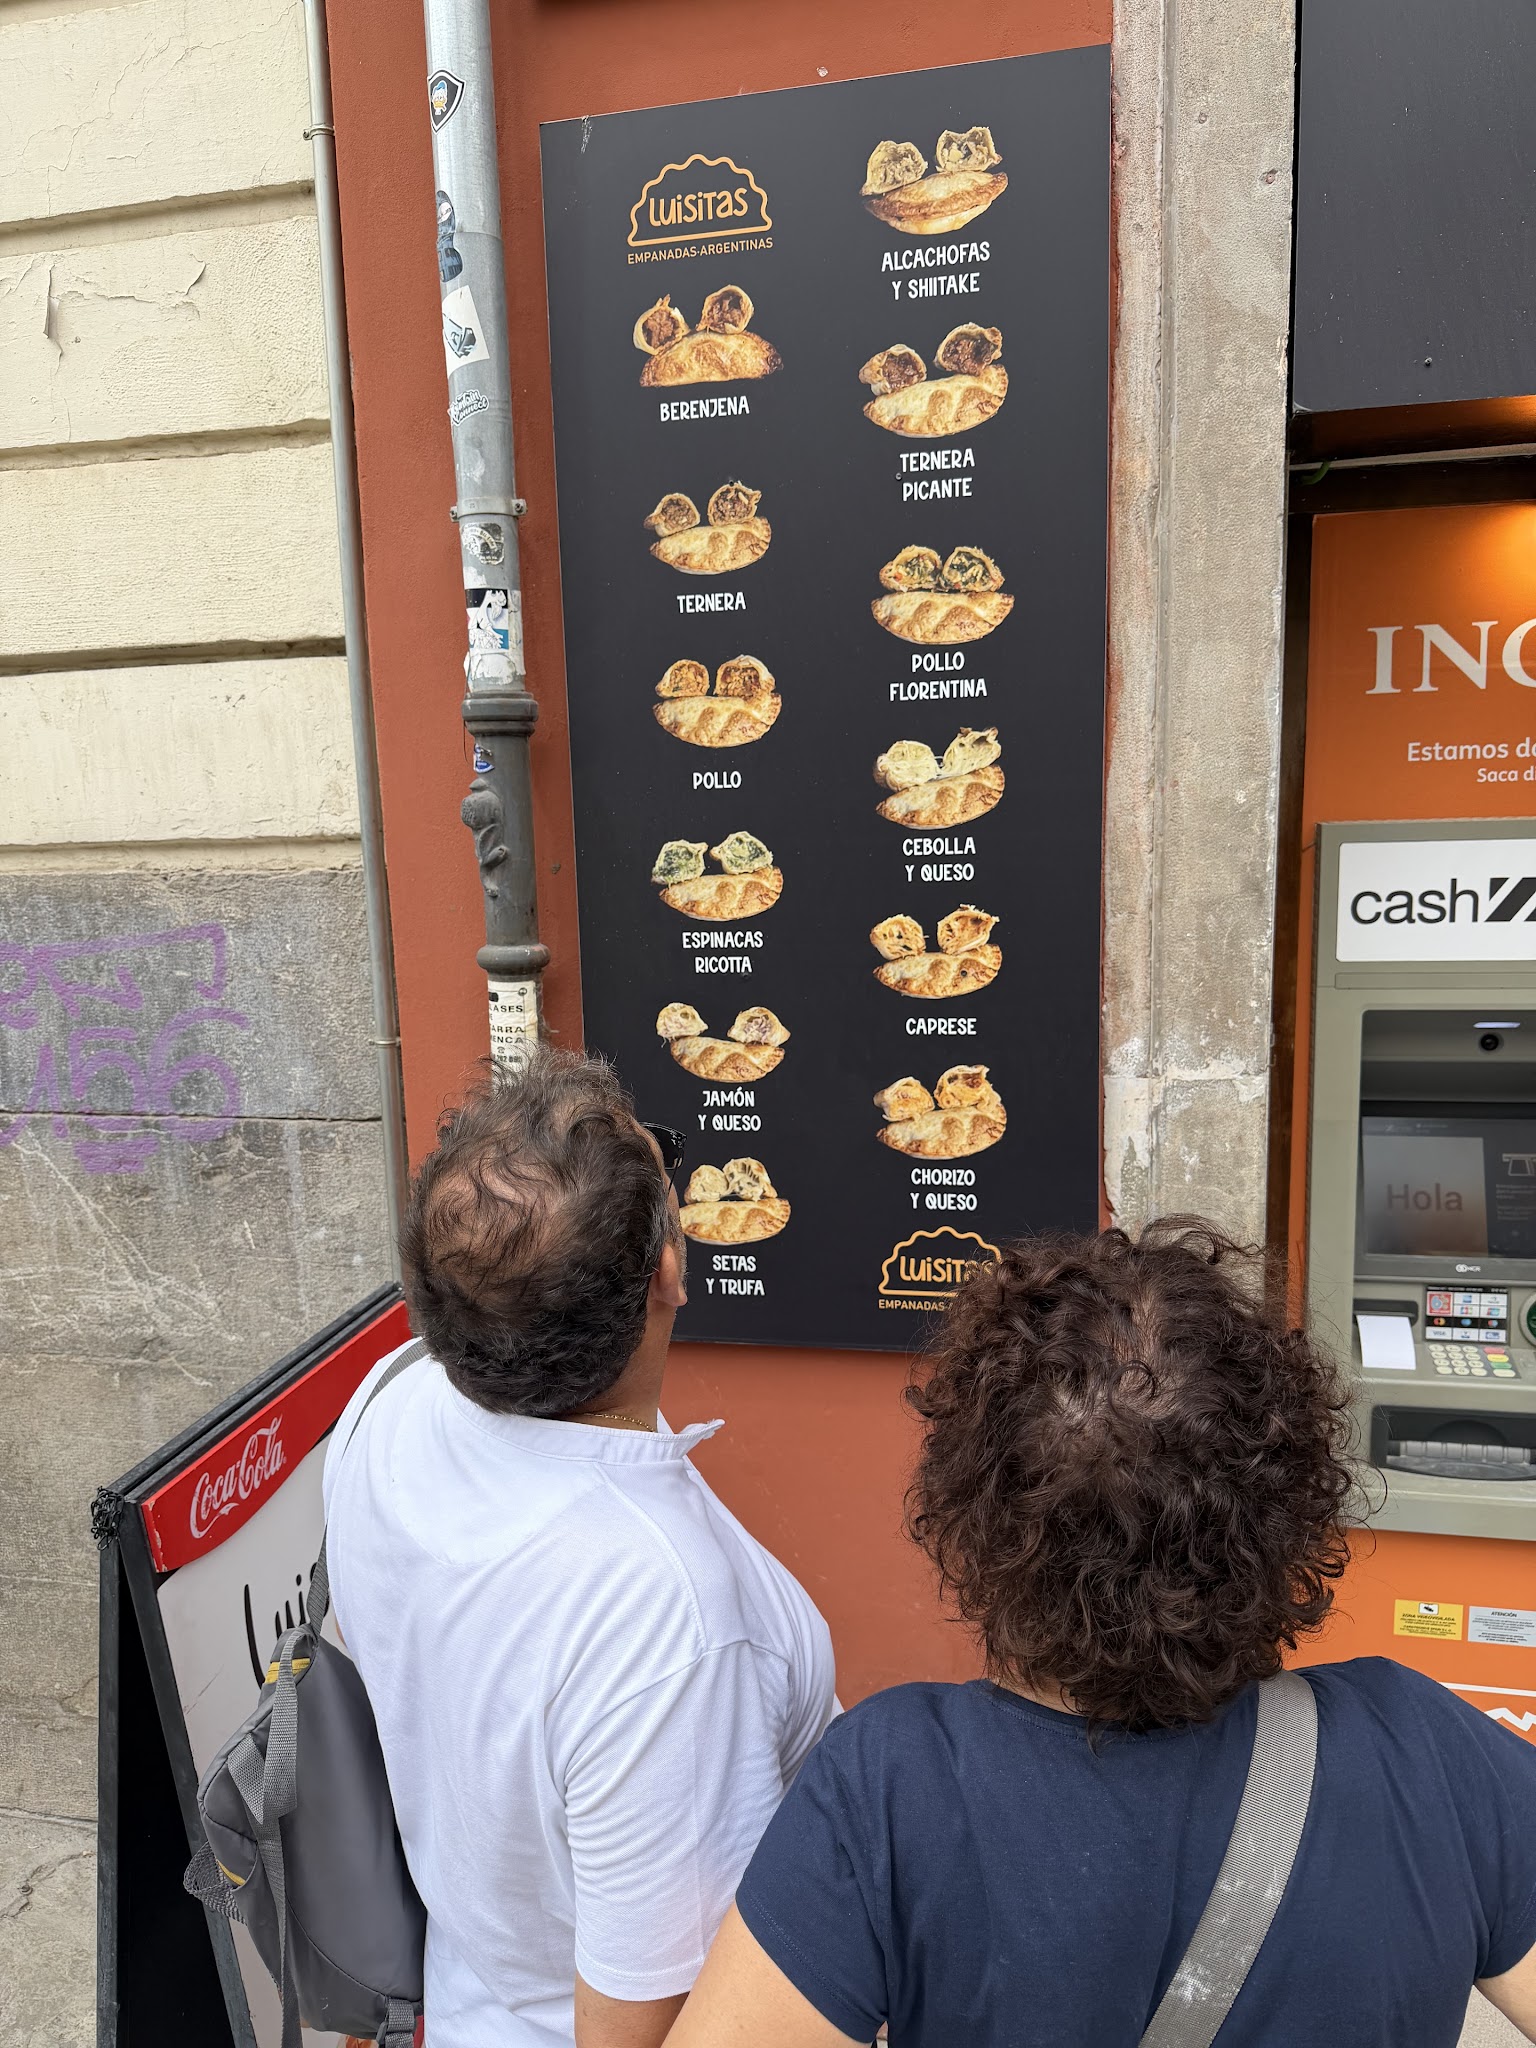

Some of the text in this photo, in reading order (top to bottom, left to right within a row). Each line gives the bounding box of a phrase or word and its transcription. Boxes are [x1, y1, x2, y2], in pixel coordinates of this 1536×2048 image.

[881, 240, 991, 272] ALCACHOFAS
[891, 272, 980, 301] Y SHIITAKE
[659, 395, 750, 422] BERENJENA
[899, 447, 976, 473] TERNERA
[902, 477, 973, 502] PICANTE
[676, 591, 747, 614] TERNERA
[911, 651, 965, 673] POLLO
[889, 678, 988, 702] FLORENTINA
[1407, 742, 1509, 762] Estamos
[692, 770, 742, 790] POLLO
[1477, 767, 1518, 783] Saca
[902, 836, 976, 857] CEBOLLA
[904, 862, 975, 882] Y QUESO
[682, 930, 764, 949] ESPINACAS
[694, 956, 753, 974] RICOTTA
[489, 1005, 524, 1013] ASES
[491, 1026, 525, 1034] ARRA
[905, 1017, 977, 1036] CAPRESE
[702, 1086, 755, 1107] JAMÓN
[697, 1114, 762, 1132] Y QUESO
[910, 1167, 976, 1187] CHORIZO
[910, 1192, 978, 1211] Y QUESO
[1387, 1182, 1463, 1211] Hola
[712, 1254, 757, 1272] SETAS
[705, 1277, 765, 1296] Y TRUFA
[190, 1413, 284, 1538] Coca-Cola
